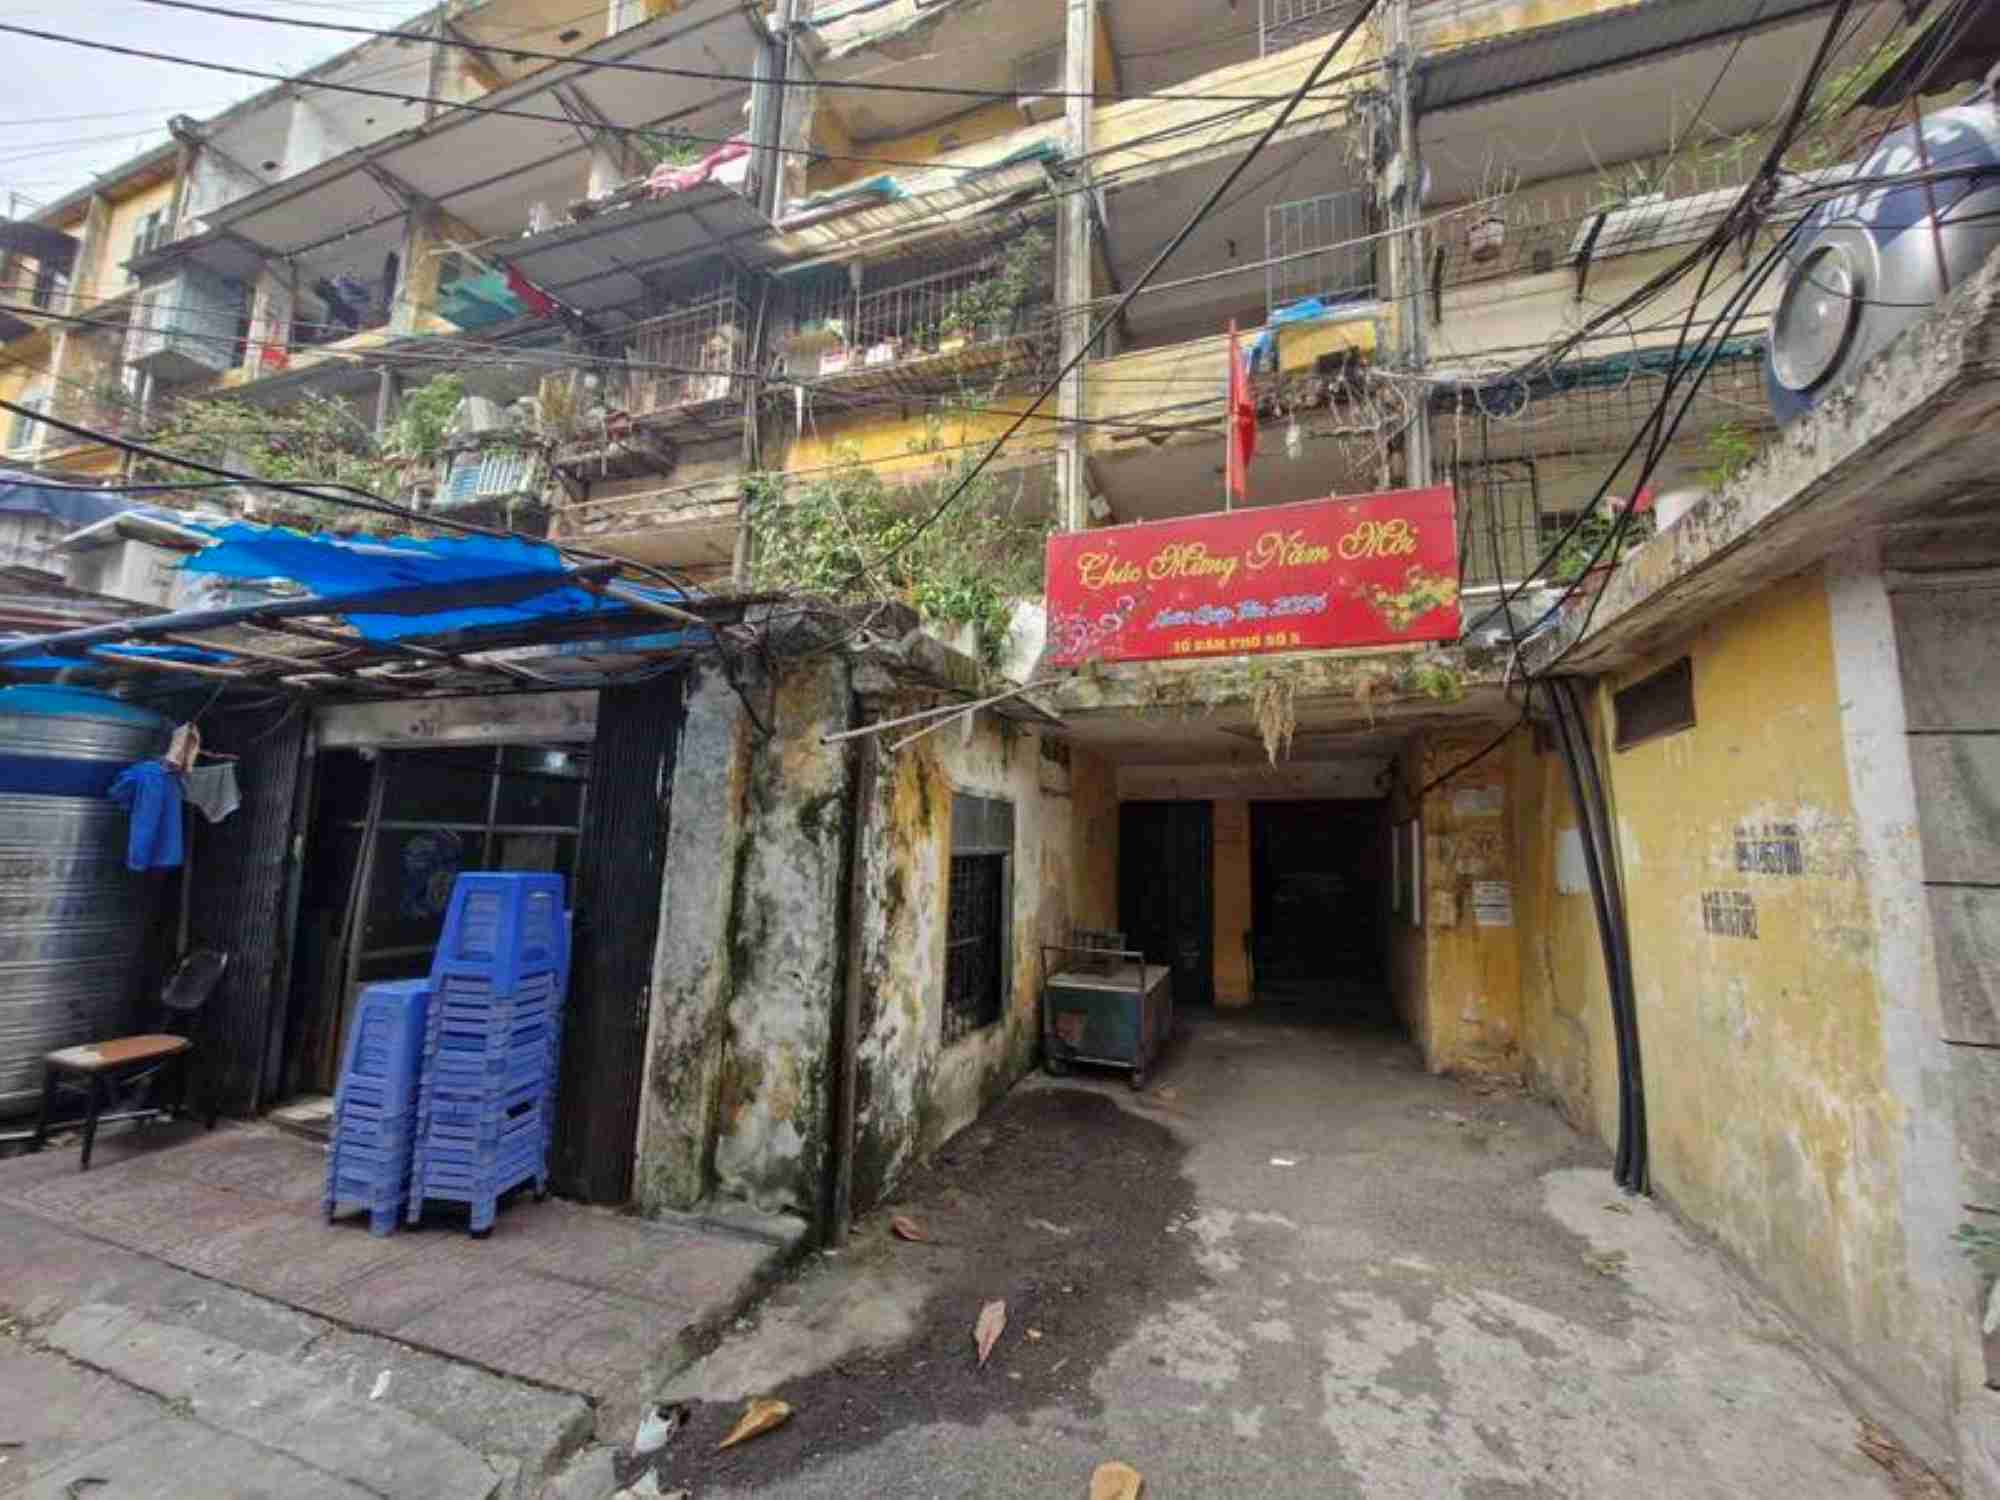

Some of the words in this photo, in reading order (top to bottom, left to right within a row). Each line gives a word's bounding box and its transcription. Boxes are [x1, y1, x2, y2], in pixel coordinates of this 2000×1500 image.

[1077, 551, 1142, 590] Chúc
[1147, 541, 1239, 589] Mừng
[1245, 529, 1329, 570] Năm
[1338, 518, 1419, 560] Mới
